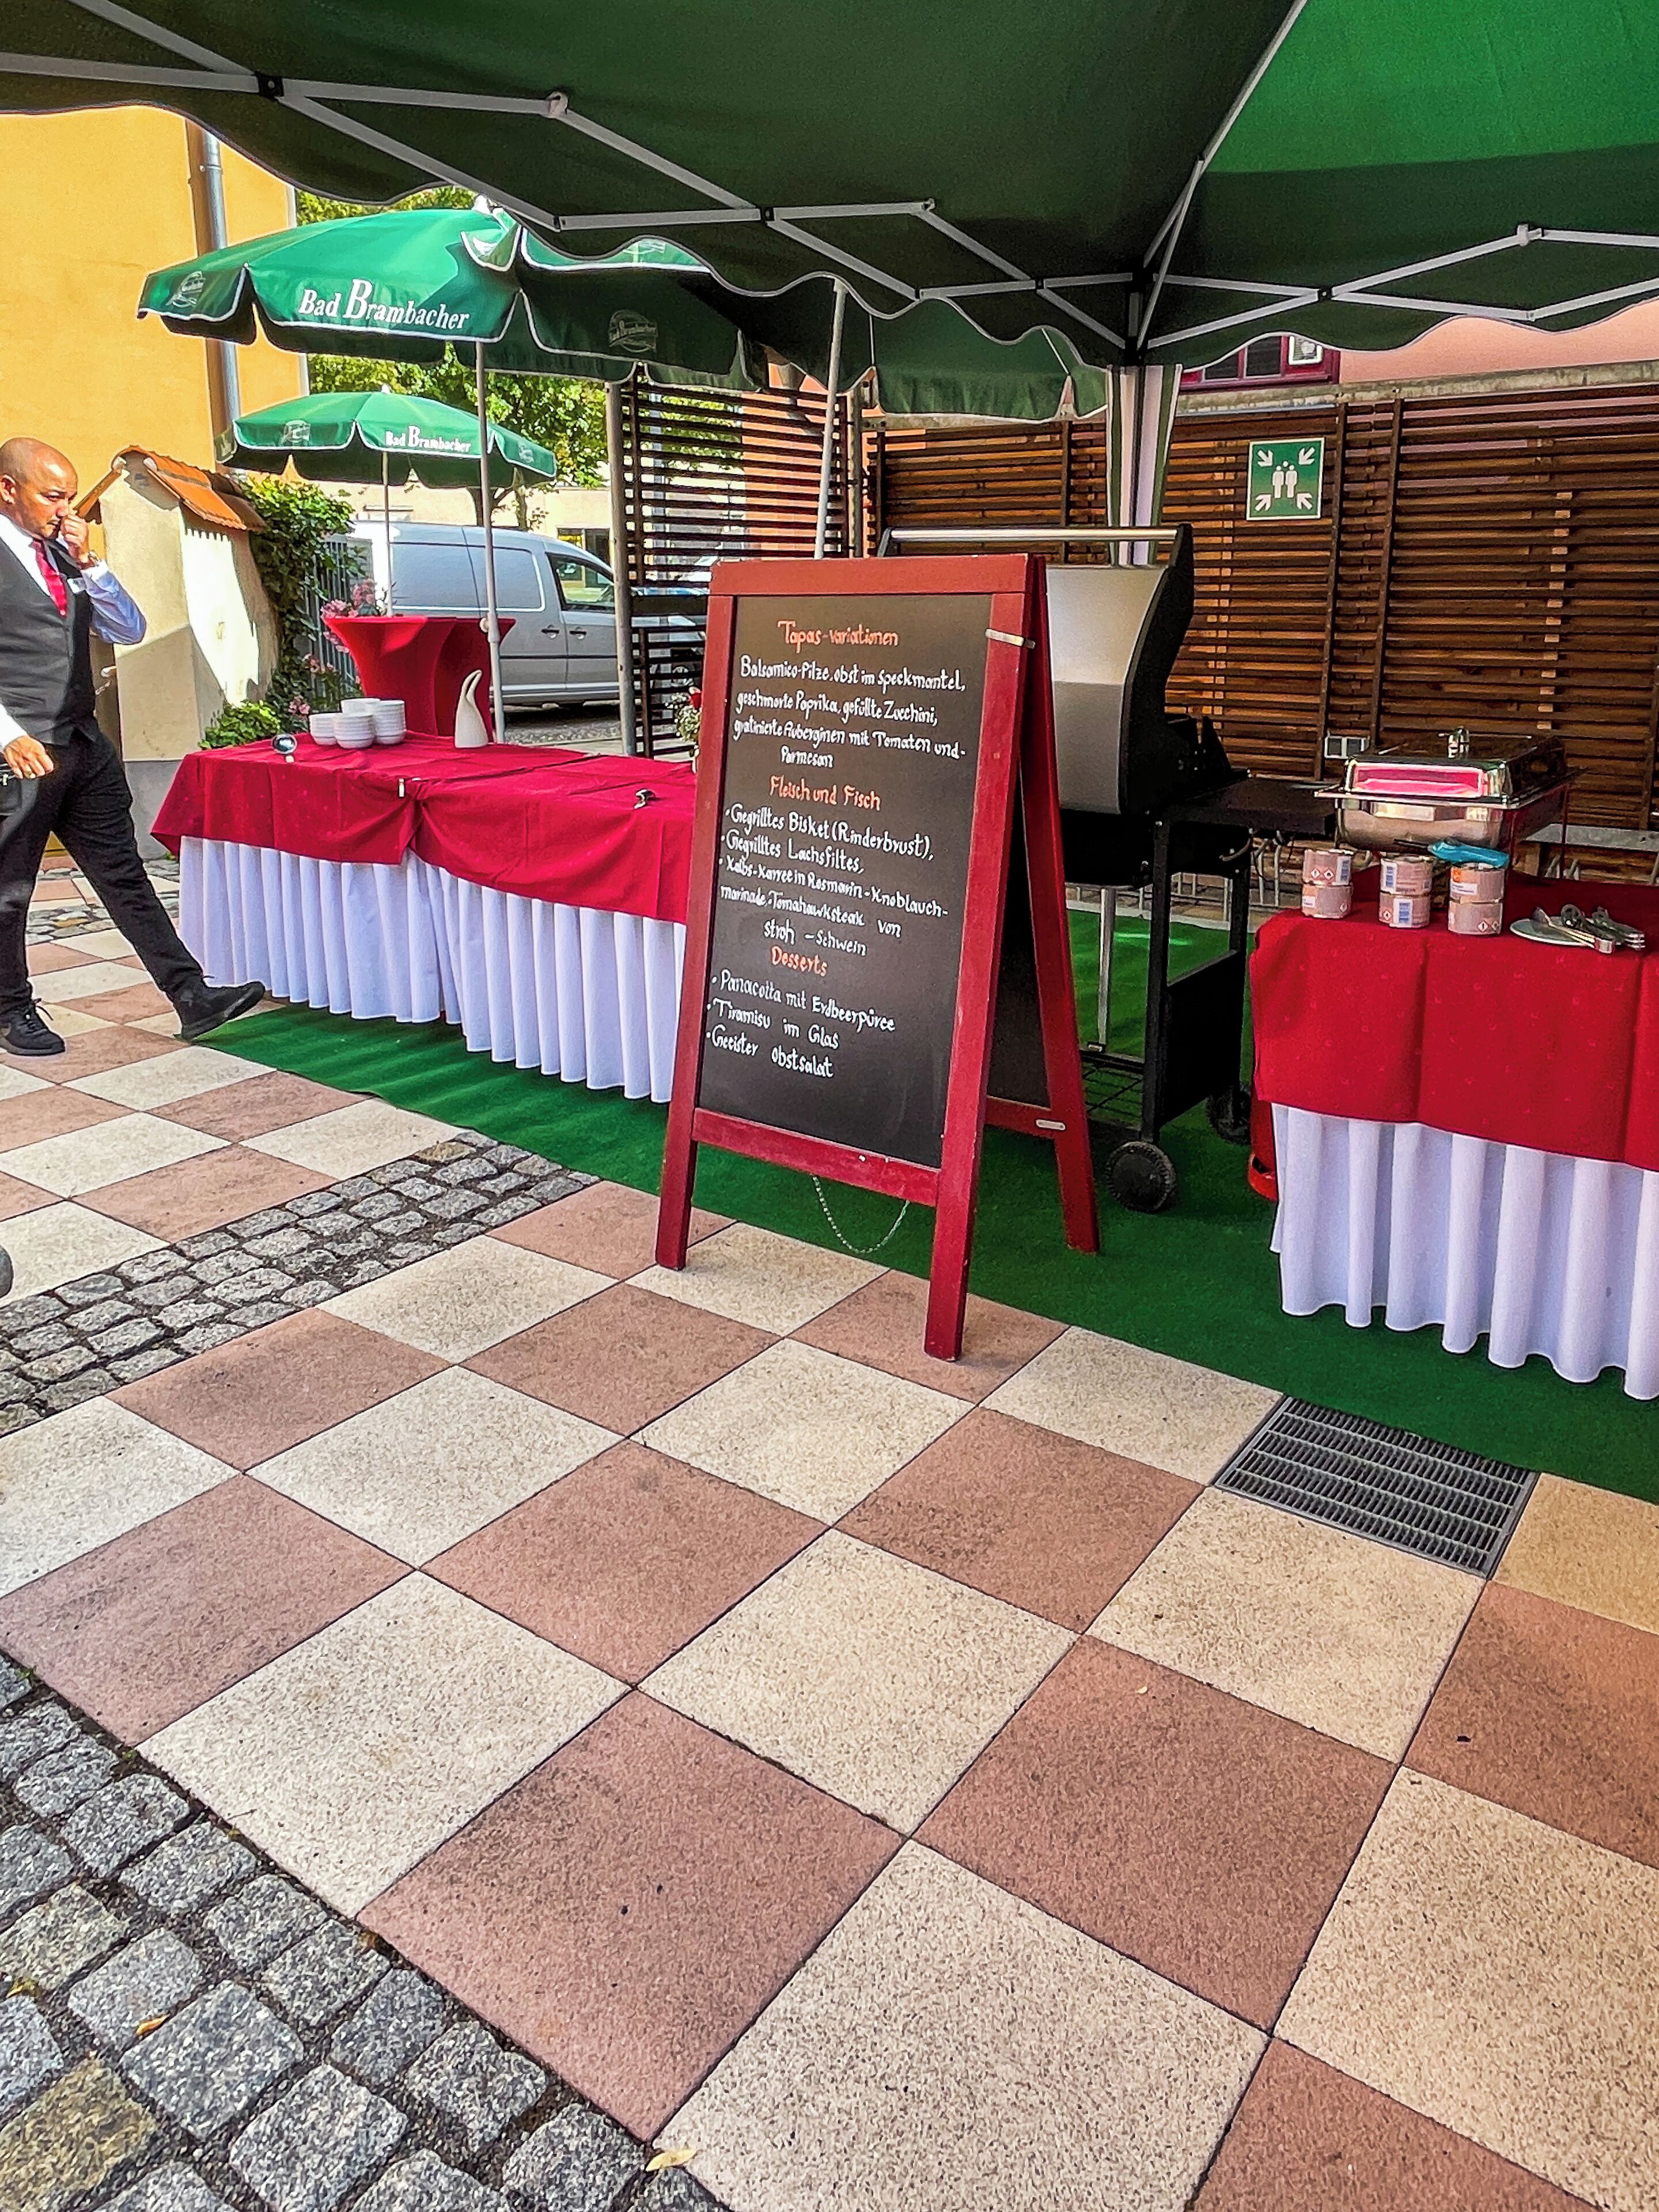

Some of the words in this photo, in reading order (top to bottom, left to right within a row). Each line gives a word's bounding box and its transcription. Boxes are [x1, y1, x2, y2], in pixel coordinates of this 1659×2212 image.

[298, 289, 342, 317] Bad
[342, 279, 470, 329] Brambacher
[385, 430, 406, 446] Bad
[407, 425, 471, 452] Brambacher
[861, 670, 875, 685] im
[736, 688, 793, 714] geschmorte
[849, 730, 870, 746] mit
[872, 731, 931, 753] Tomaten
[781, 746, 834, 768] Parmesan
[770, 775, 810, 801] Fleisch
[813, 785, 836, 805] und
[843, 785, 880, 811] Fisch
[789, 811, 830, 839] Bisket
[794, 870, 805, 885] in
[771, 945, 828, 976] Desserts
[720, 969, 782, 1003] Panacotta
[786, 990, 806, 1009] mit
[713, 998, 771, 1029] Tiramisu
[783, 1018, 800, 1037] im
[808, 1025, 839, 1049] Glas
